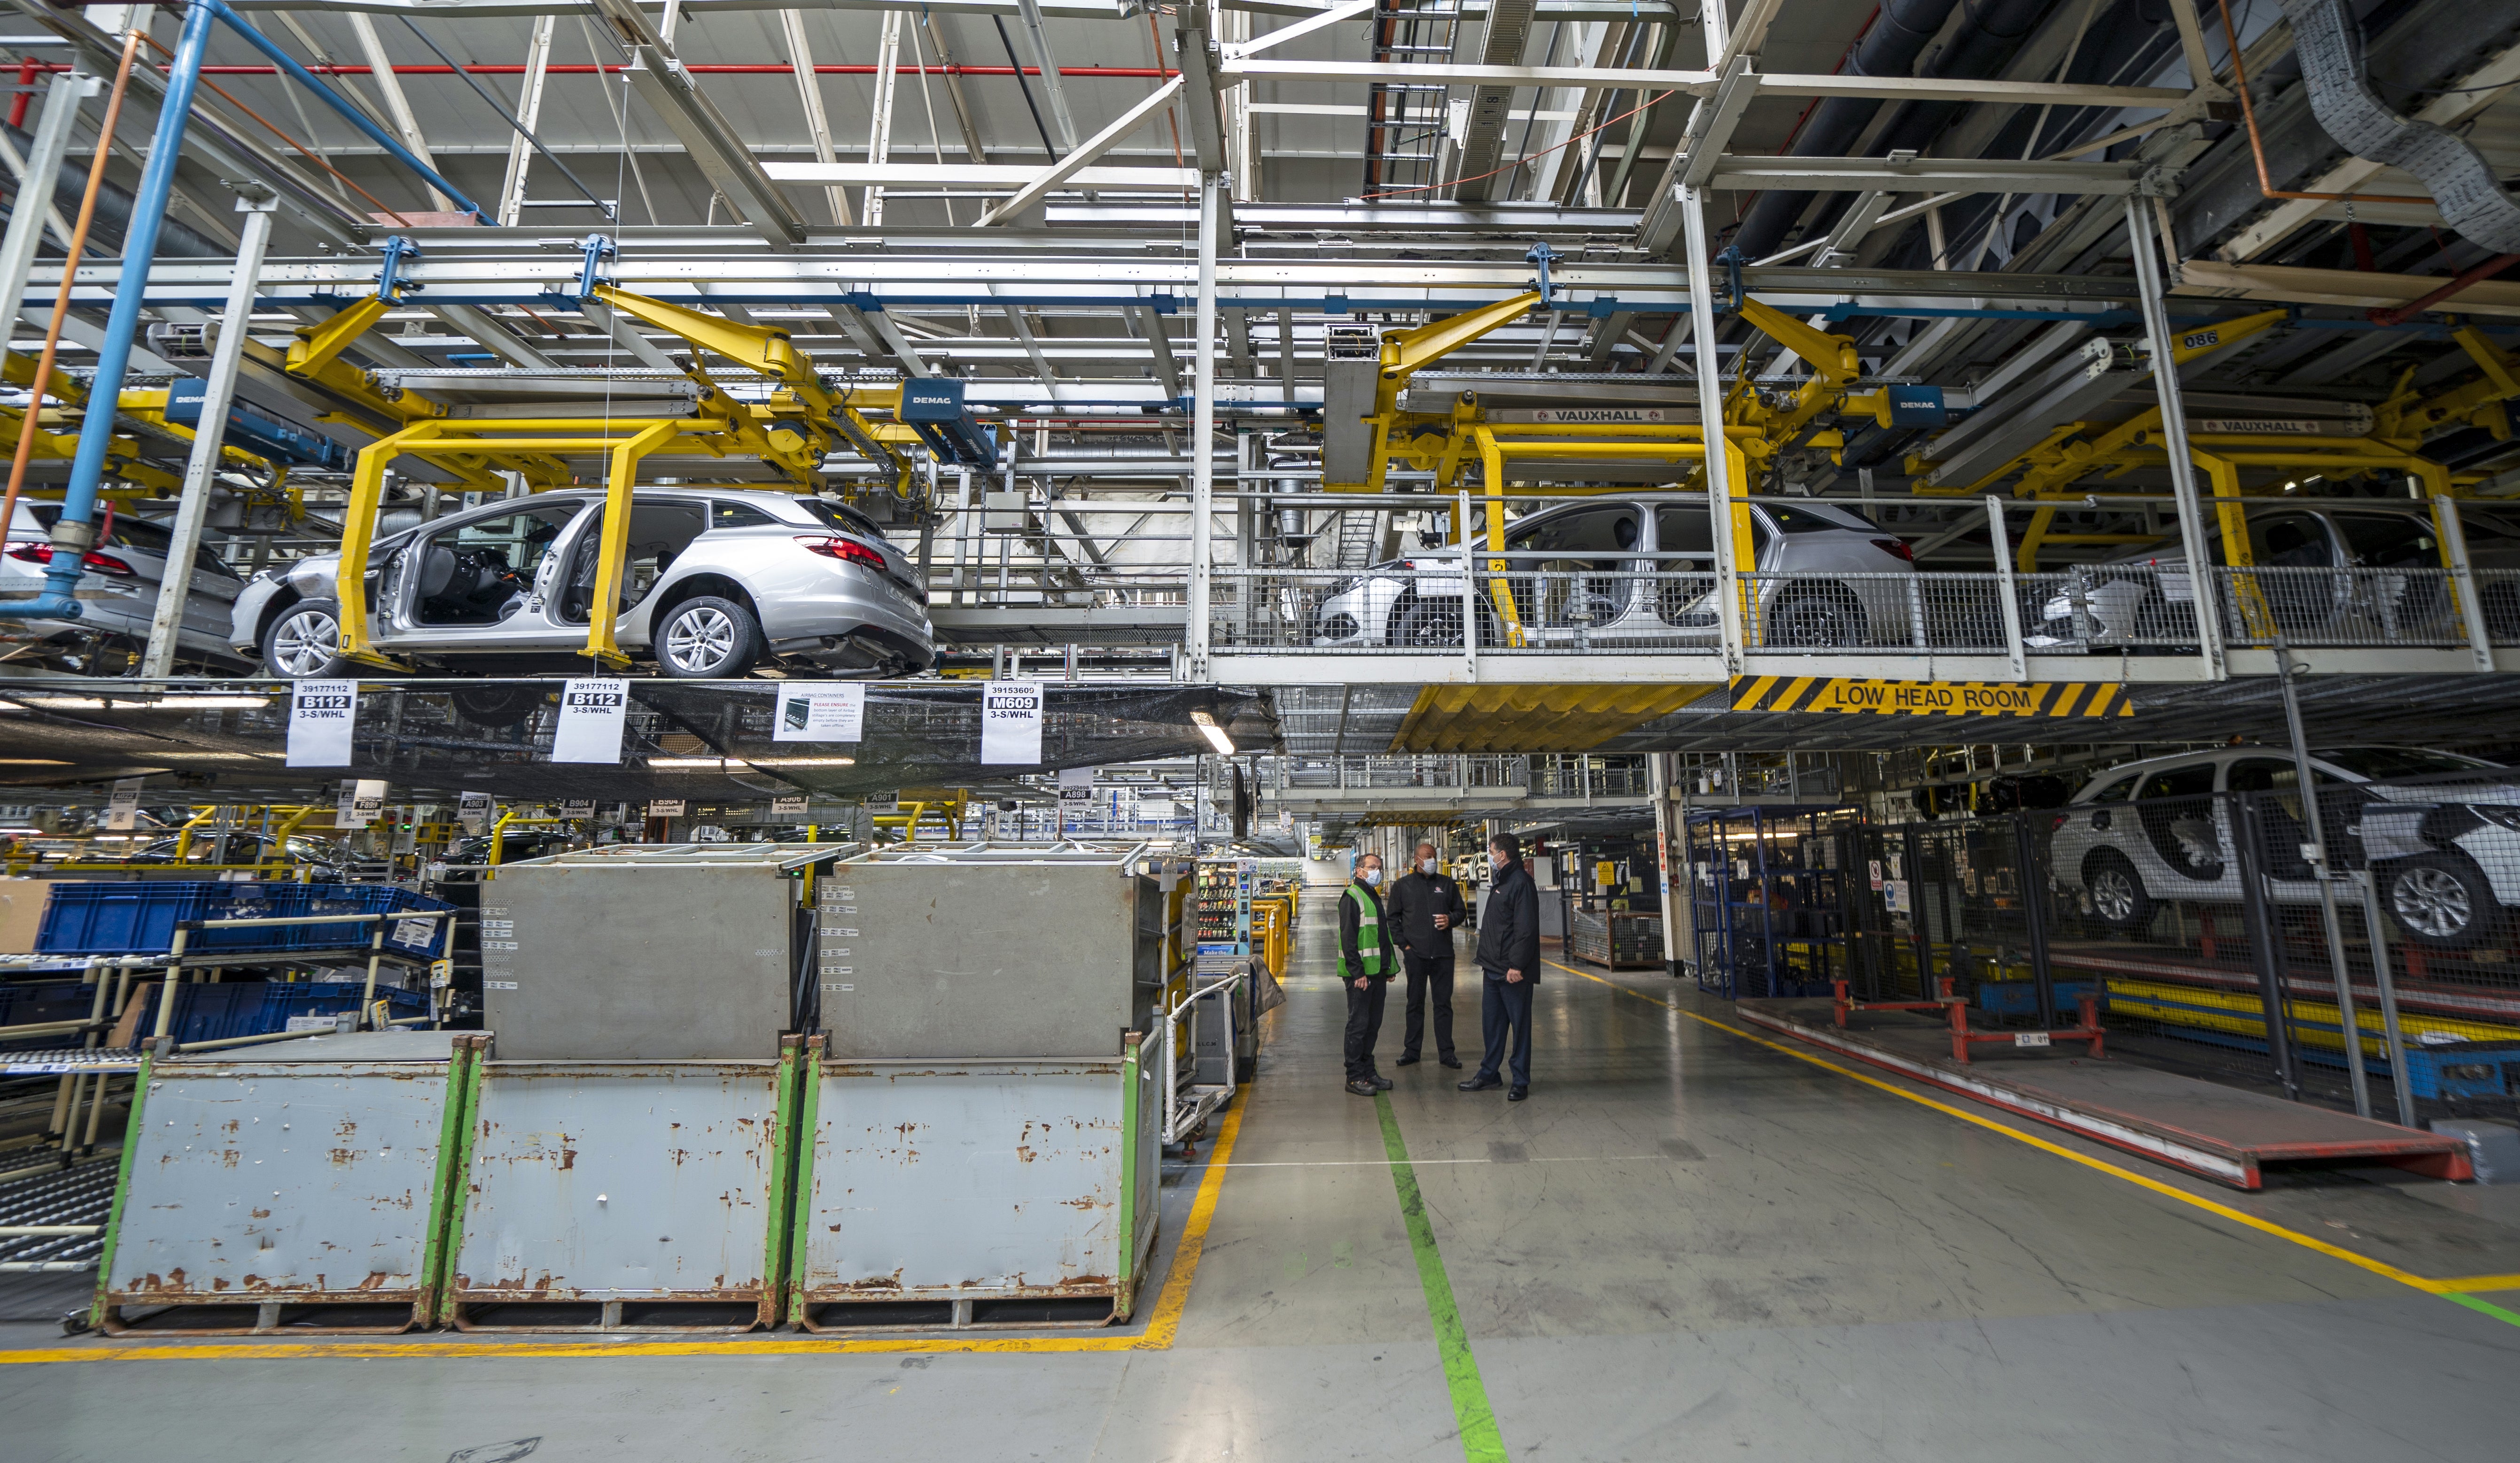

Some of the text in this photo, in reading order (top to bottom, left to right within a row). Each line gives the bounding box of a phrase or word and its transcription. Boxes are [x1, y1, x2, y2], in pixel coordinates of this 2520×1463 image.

[2185, 333, 2217, 348] 086
[1555, 411, 1642, 420] VAUXHALL
[2222, 422, 2300, 431] VAUXHALL
[966, 438, 983, 455] DEMAG
[303, 696, 346, 708] B112
[574, 693, 616, 705] B112
[993, 698, 1034, 708] M609
[1835, 686, 2031, 708] LOW HEAD ROOM
[1656, 781, 1660, 791] M
